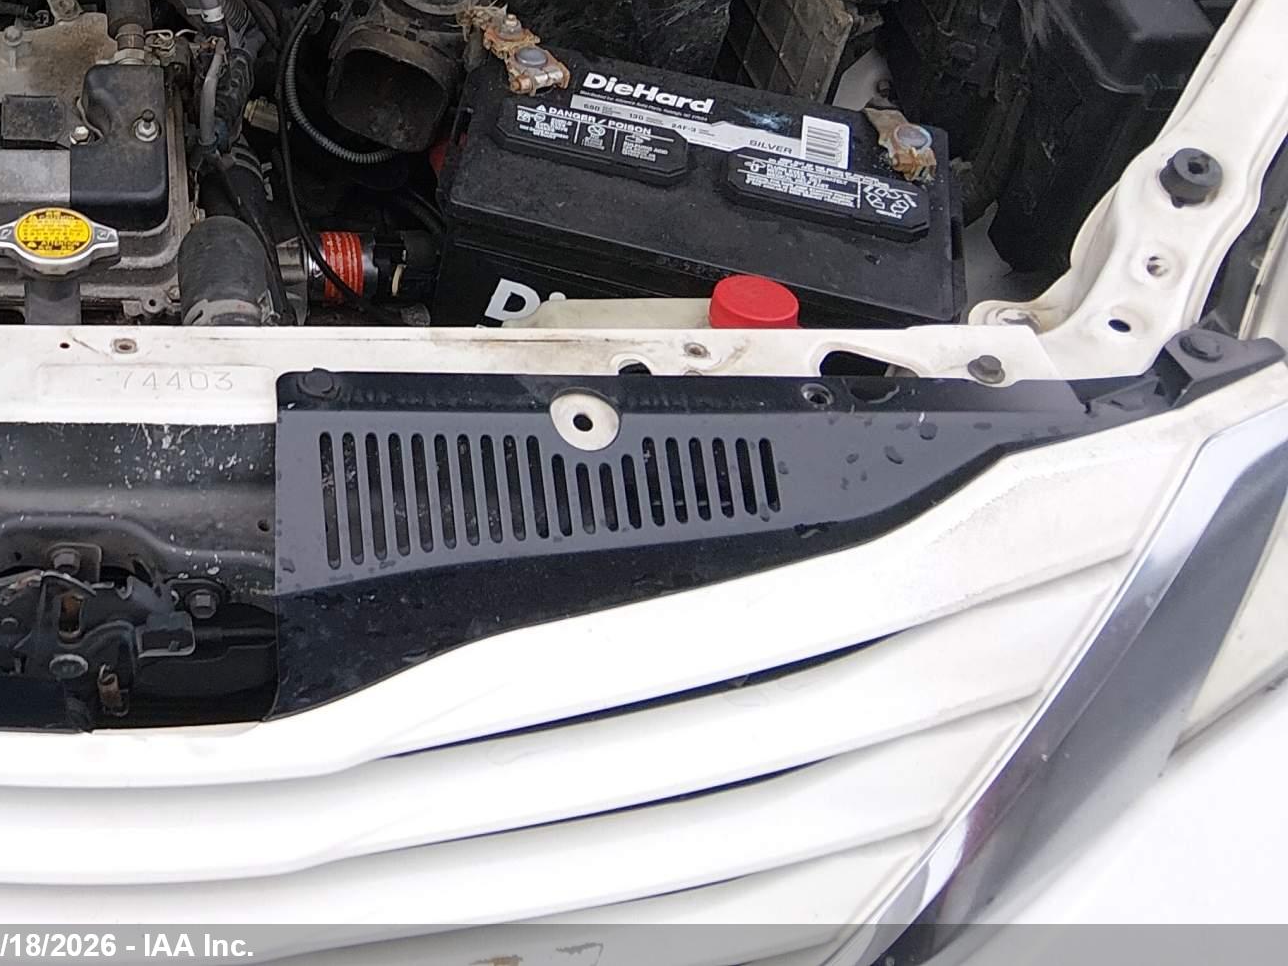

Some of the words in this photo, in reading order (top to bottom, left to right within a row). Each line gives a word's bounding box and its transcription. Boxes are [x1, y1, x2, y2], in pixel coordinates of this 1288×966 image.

[582, 72, 715, 114] DieHard
[548, 106, 596, 124] DANGER
[608, 120, 652, 135] POISON
[749, 139, 793, 155] SILVER
